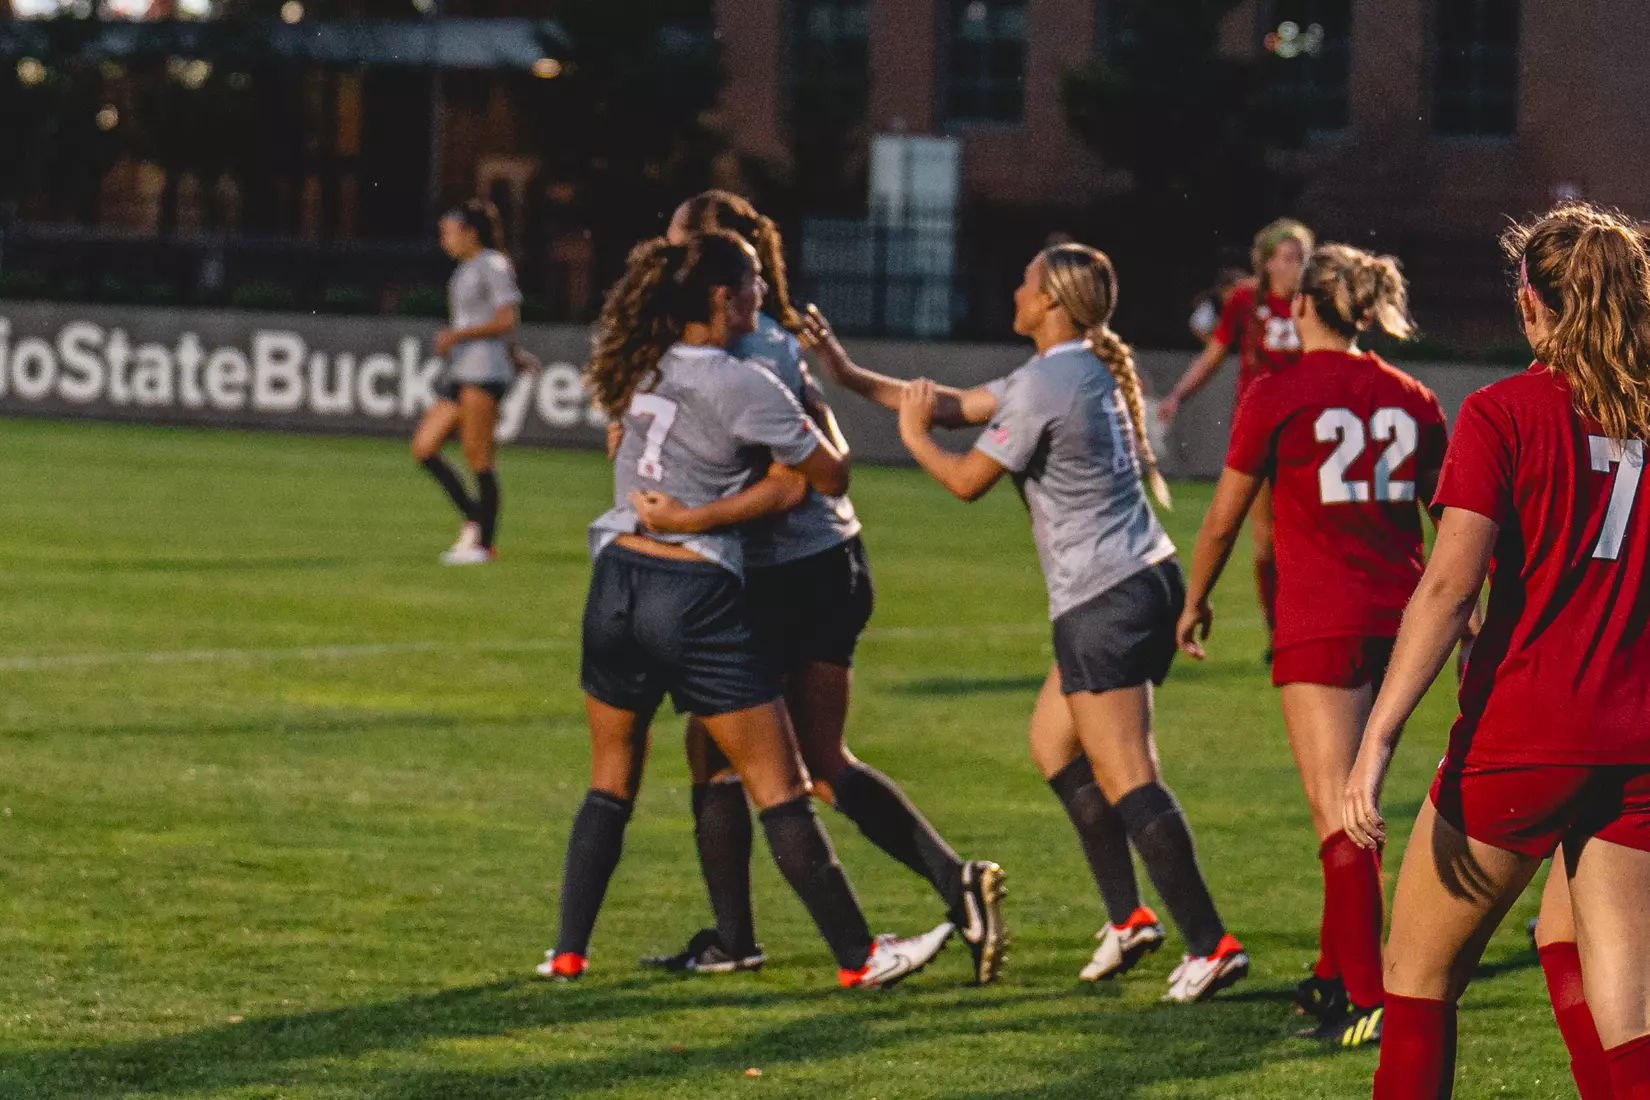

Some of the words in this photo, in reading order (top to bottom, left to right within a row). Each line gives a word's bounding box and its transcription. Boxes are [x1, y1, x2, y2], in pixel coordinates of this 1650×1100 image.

[630, 393, 678, 482] 7
[1314, 407, 1418, 504] 22
[1588, 434, 1643, 560] 7
